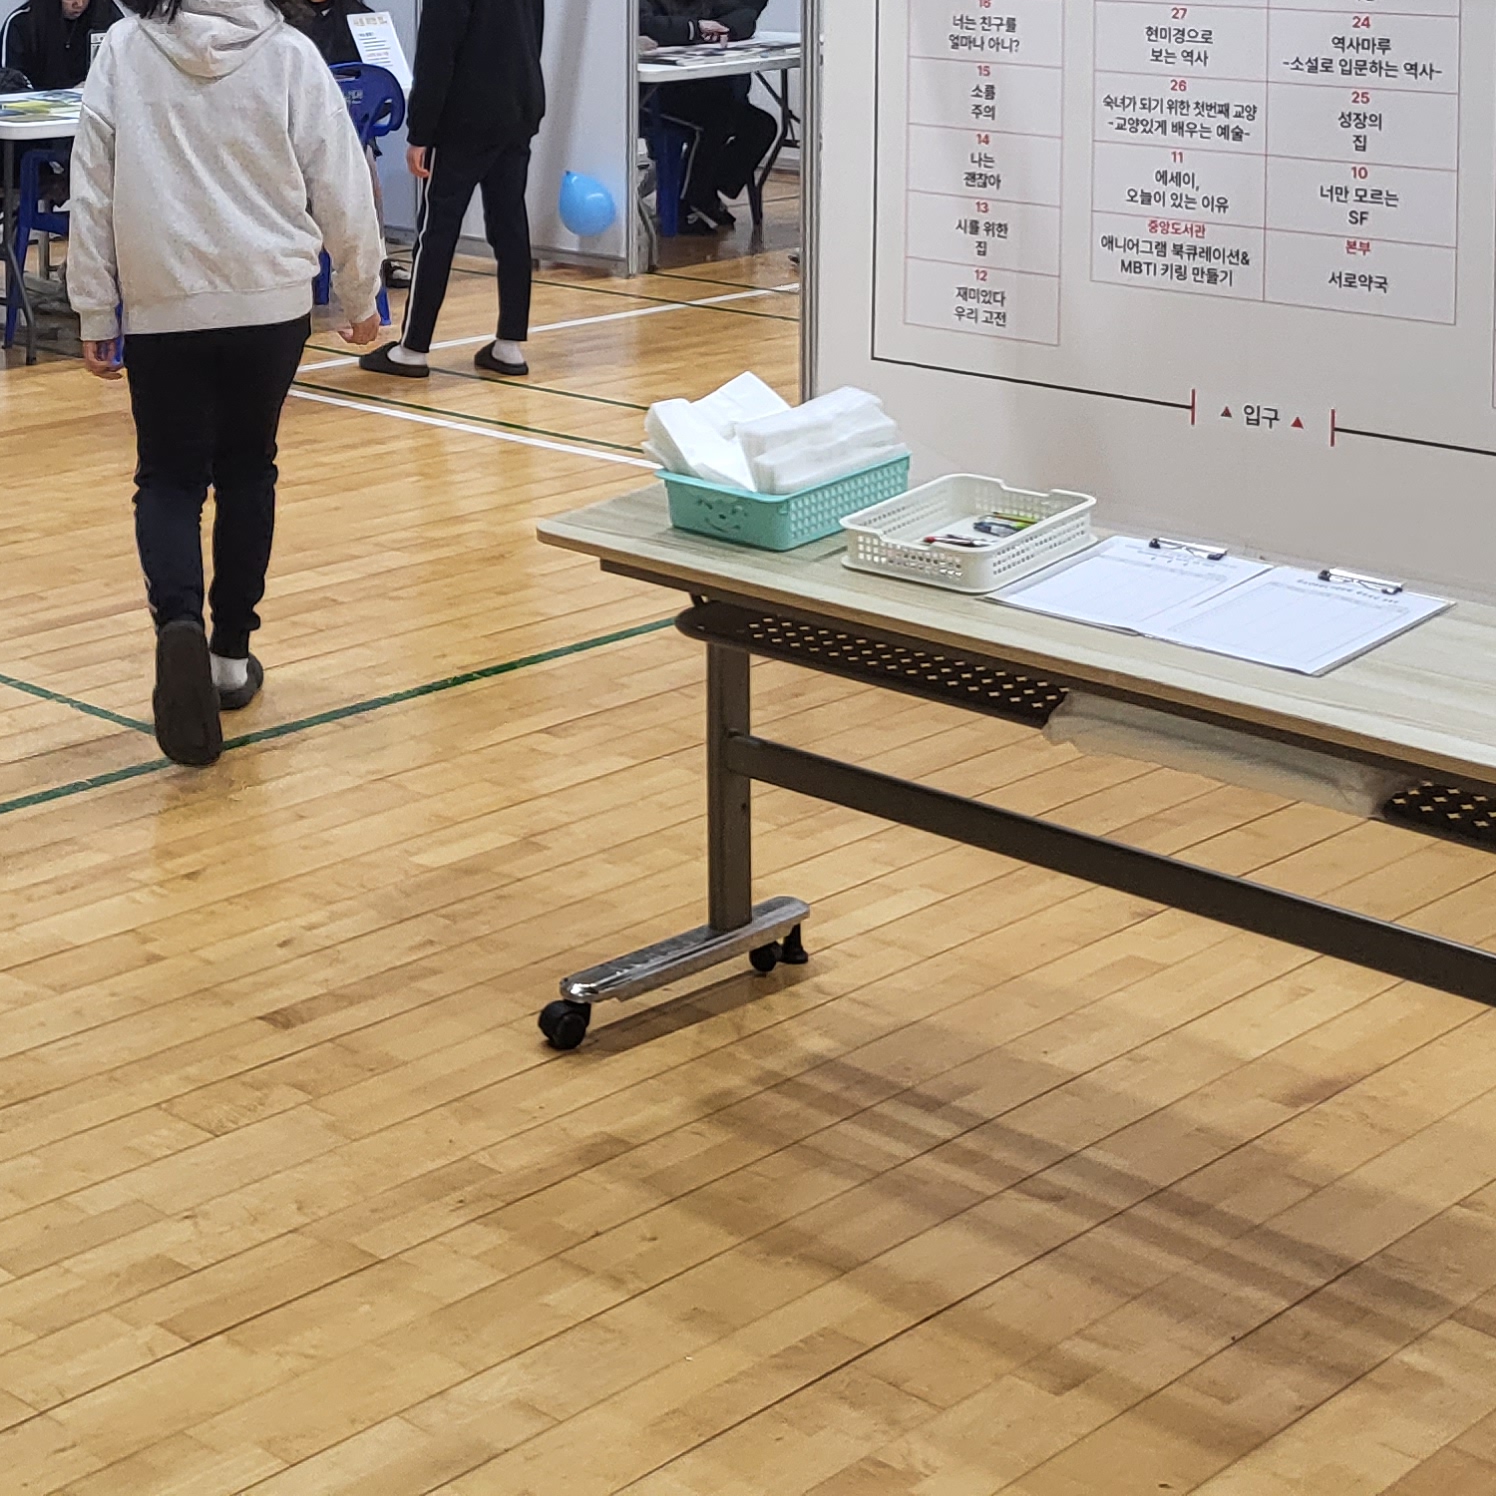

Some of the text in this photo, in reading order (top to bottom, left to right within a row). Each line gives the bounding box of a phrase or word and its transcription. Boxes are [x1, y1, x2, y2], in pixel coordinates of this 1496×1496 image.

[1171, 7, 1187, 19] 27
[1352, 16, 1371, 28] 24
[953, 14, 1017, 33] 너는 친구를
[949, 34, 1020, 53] 얼마나 아니?
[1145, 26, 1214, 44] 현미경으로
[1332, 36, 1392, 55] 역사마루
[1150, 48, 1208, 67] 보는 역사
[977, 66, 990, 76] 15
[1339, 58, 1399, 78] 입문하는
[971, 84, 996, 100] 소름
[1171, 79, 1187, 92] 26
[1352, 91, 1370, 104] 25
[971, 104, 996, 120] 주의
[1103, 95, 1257, 121] 숙녀가 되기 위한 첫번째 교양
[1171, 121, 1212, 139] 배우는
[1338, 112, 1382, 131] 성장의
[976, 134, 990, 145] 14
[1353, 135, 1367, 152] 집
[971, 153, 995, 168] 나는
[1171, 152, 1183, 163] 11
[963, 172, 1001, 190] 괜찮아
[1155, 170, 1200, 191] 에세이,
[1352, 167, 1368, 179] 10
[1126, 188, 1229, 214] 오늘이 있는 이유
[1320, 185, 1399, 207] 너만 모르는
[976, 202, 989, 214] 13
[1348, 211, 1369, 225] SF
[956, 219, 1008, 239] 시를 위한
[1148, 220, 1206, 239] 중앙도서관
[975, 241, 987, 256] 집
[1346, 240, 1371, 256] 본부
[975, 269, 988, 282] 12
[1121, 260, 1233, 286] MBTI 키링 만들기
[1328, 271, 1388, 293] 서로약국
[956, 286, 1006, 307] 재미있다
[954, 306, 1007, 327] 우리 고전
[1244, 405, 1280, 429] 입구
